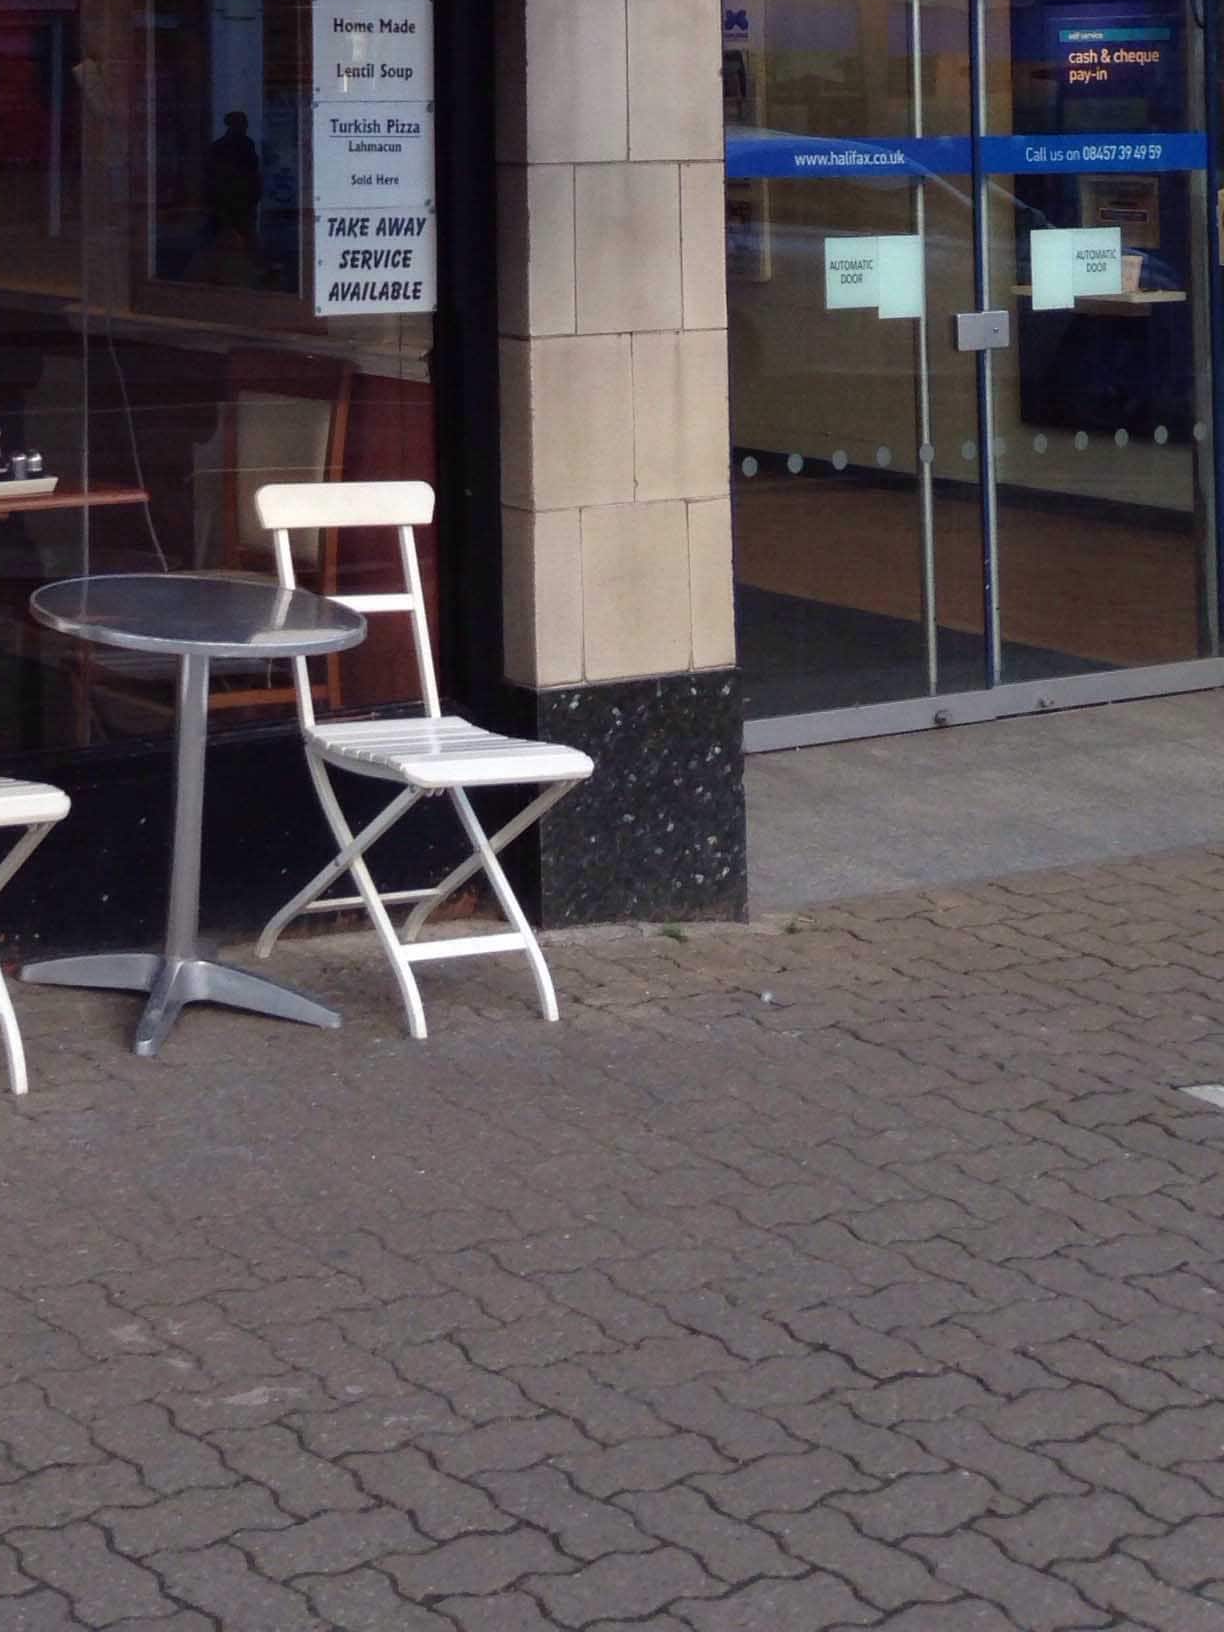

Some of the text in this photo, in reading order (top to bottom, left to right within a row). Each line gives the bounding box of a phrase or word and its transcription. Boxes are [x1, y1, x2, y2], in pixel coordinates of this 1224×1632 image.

[333, 18, 416, 34] Home Made
[1068, 48, 1161, 66] cash & cheque
[337, 64, 414, 82] Lentil Soup
[1069, 67, 1108, 84] pay-in
[330, 119, 421, 135] Turkish Pizza
[348, 141, 402, 154] Lahmacun
[1025, 146, 1047, 162] Call
[1050, 149, 1064, 161] us
[1066, 149, 1081, 161] on
[1082, 146, 1116, 160] 08457
[794, 149, 905, 167] www.halifax.co.uk
[351, 174, 399, 187] Sold Here
[328, 217, 427, 238] TAKE AWAY
[339, 249, 413, 271] SERVICE
[1075, 248, 1117, 261] AUTOMATIC
[829, 259, 873, 272] AUTOMATIC
[1086, 262, 1107, 273] DOOR
[840, 274, 864, 285] DOOR
[329, 281, 423, 303] AVAILABLE
